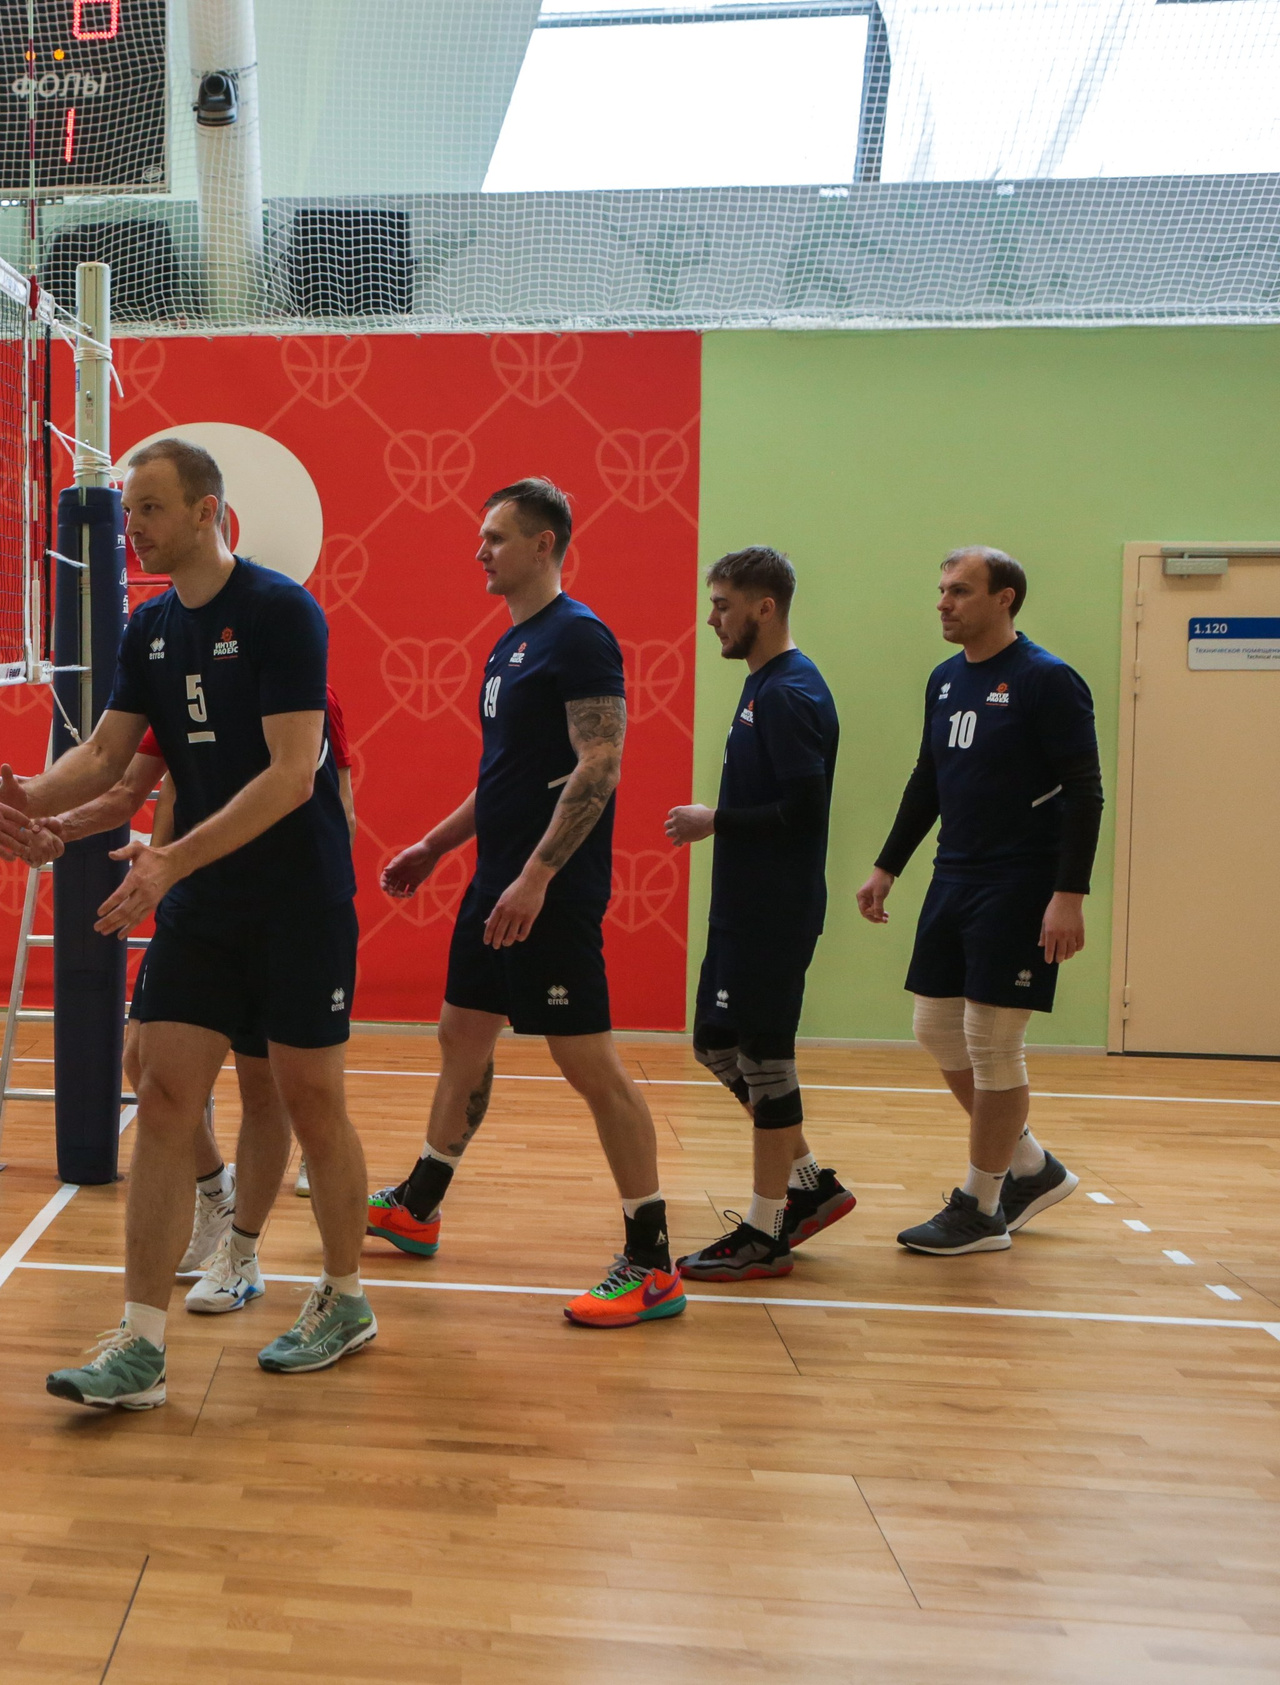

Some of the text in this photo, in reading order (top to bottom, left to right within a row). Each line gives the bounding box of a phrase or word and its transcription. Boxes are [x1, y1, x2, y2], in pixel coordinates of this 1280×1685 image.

[11, 72, 108, 98] ФОЛЫ
[64, 107, 76, 163] 1
[1193, 623, 1228, 635] 1.120
[185, 674, 208, 723] 5
[483, 675, 502, 718] 19
[948, 710, 978, 749] 10
